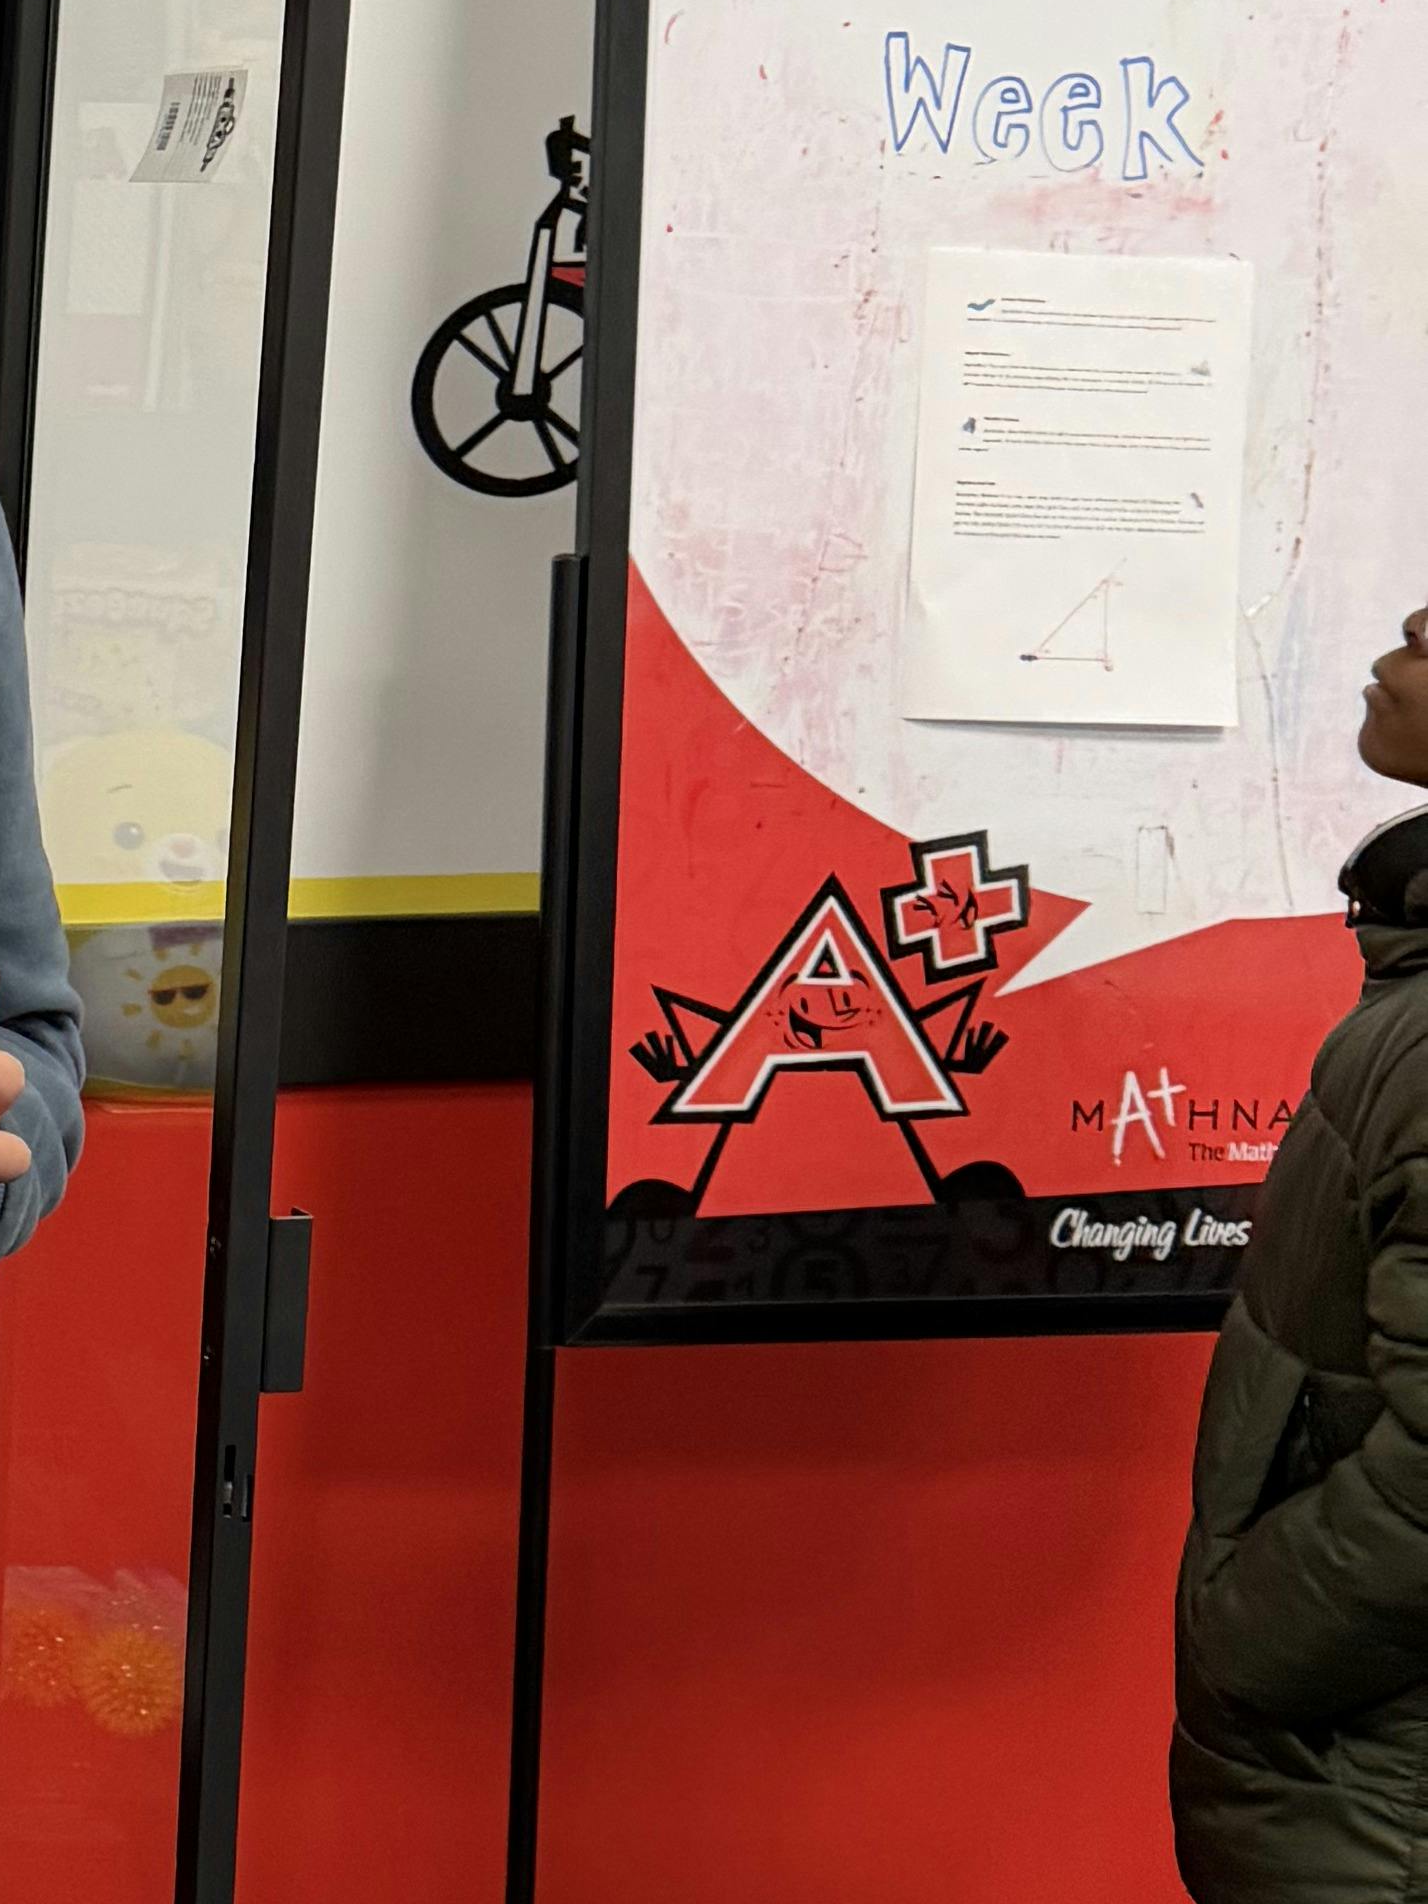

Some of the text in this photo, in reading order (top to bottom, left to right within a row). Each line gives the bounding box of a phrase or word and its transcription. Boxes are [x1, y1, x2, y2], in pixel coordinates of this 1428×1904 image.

[882, 30, 1207, 181] Week
[1189, 1142, 1225, 1163] The
[1050, 1207, 1253, 1262] Changing Lives
